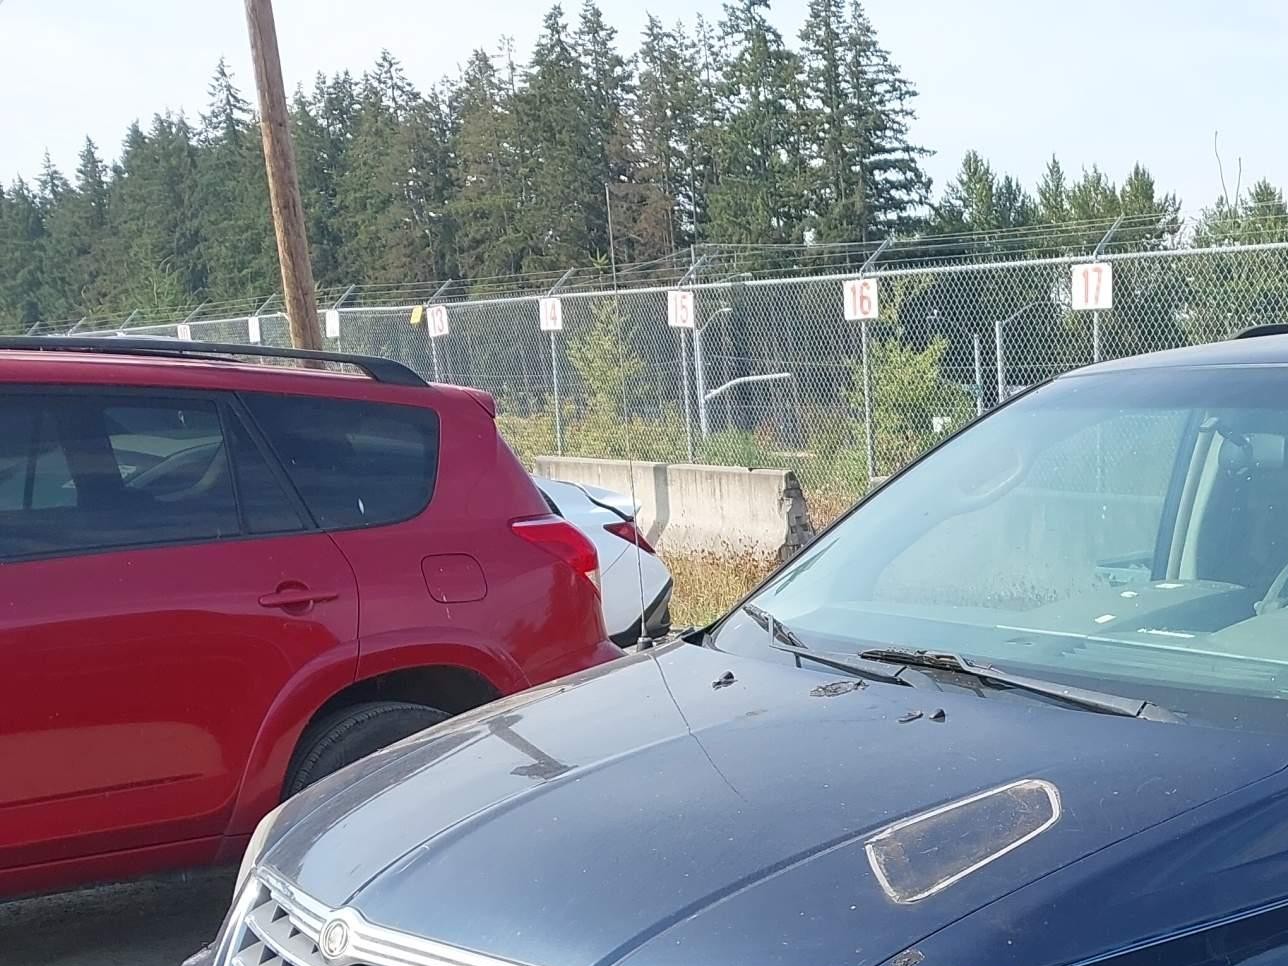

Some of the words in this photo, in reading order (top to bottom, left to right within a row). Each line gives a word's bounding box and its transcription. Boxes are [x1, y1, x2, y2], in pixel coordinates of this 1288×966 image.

[849, 282, 873, 316] 16
[1082, 266, 1104, 306] 17
[431, 307, 445, 334] 13
[544, 302, 558, 327] 14
[674, 293, 689, 324] 15
